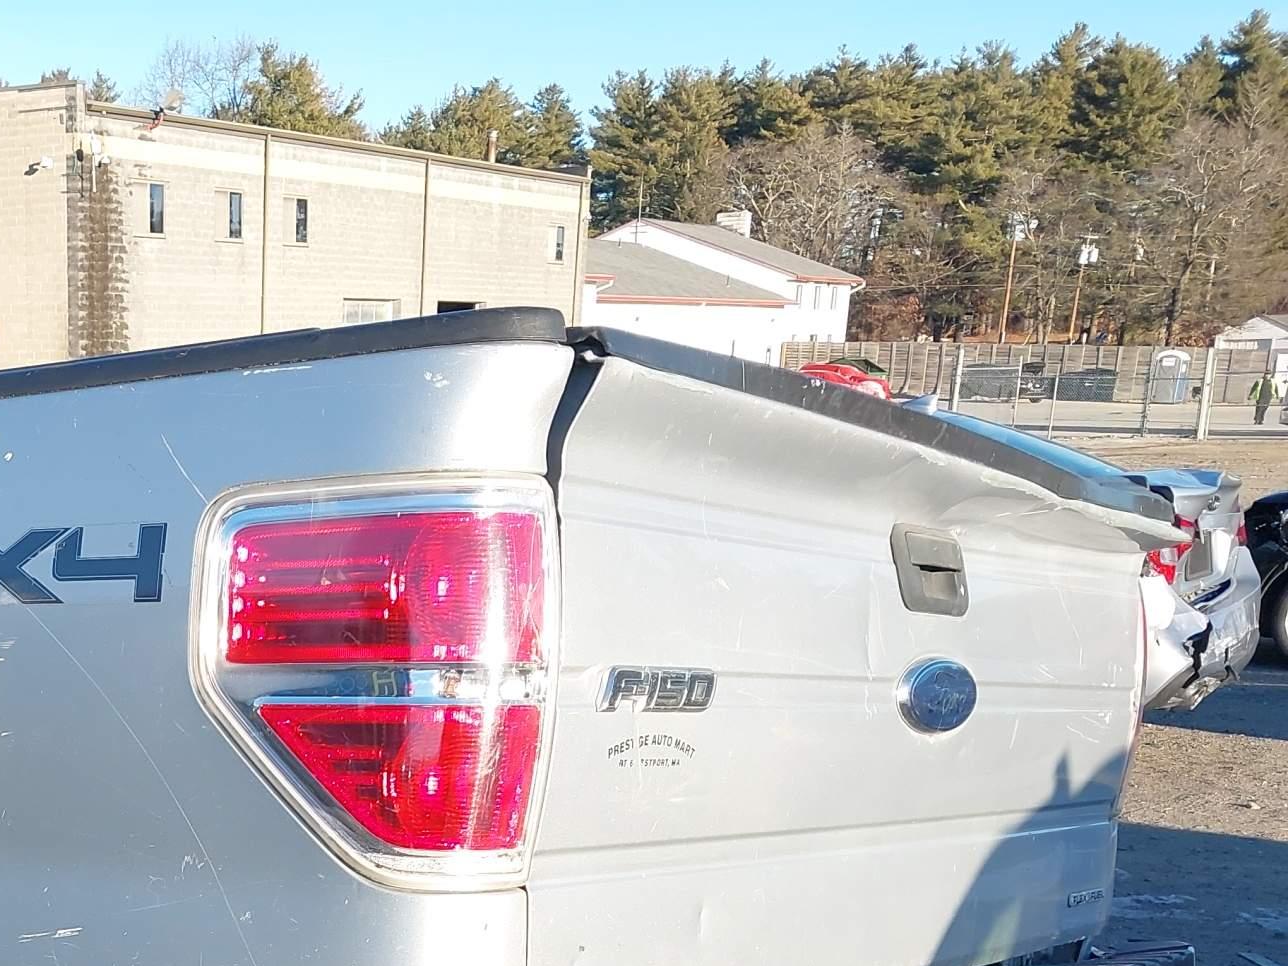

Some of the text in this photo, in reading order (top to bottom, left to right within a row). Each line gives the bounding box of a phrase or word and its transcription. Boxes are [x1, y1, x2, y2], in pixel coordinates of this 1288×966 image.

[607, 734, 696, 759] PRESTGE AUTO MART
[640, 758, 670, 768] STPORT,
